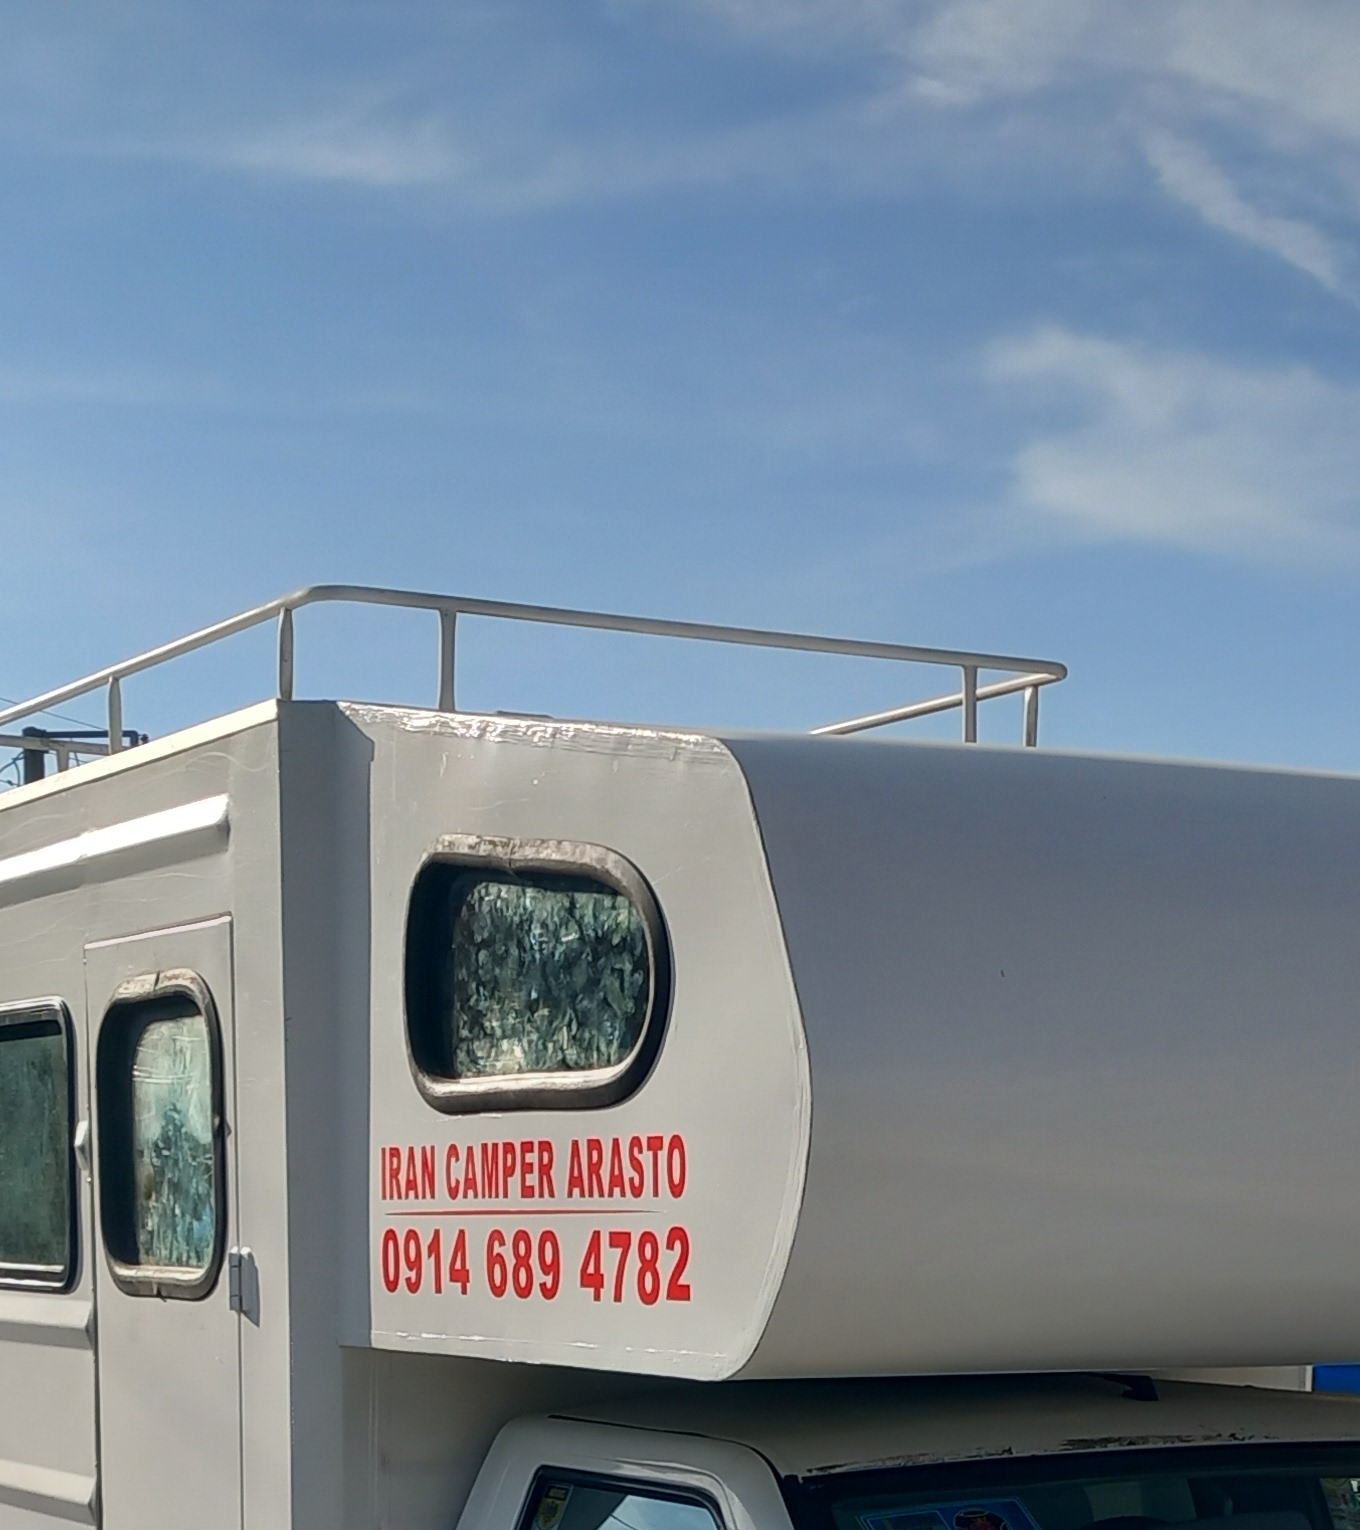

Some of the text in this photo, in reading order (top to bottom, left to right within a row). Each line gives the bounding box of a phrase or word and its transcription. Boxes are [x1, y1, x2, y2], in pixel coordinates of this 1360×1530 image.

[380, 1134, 687, 1201] IRAN CAMPER ARASTO
[381, 1226, 692, 1305] 0914 689 4782
